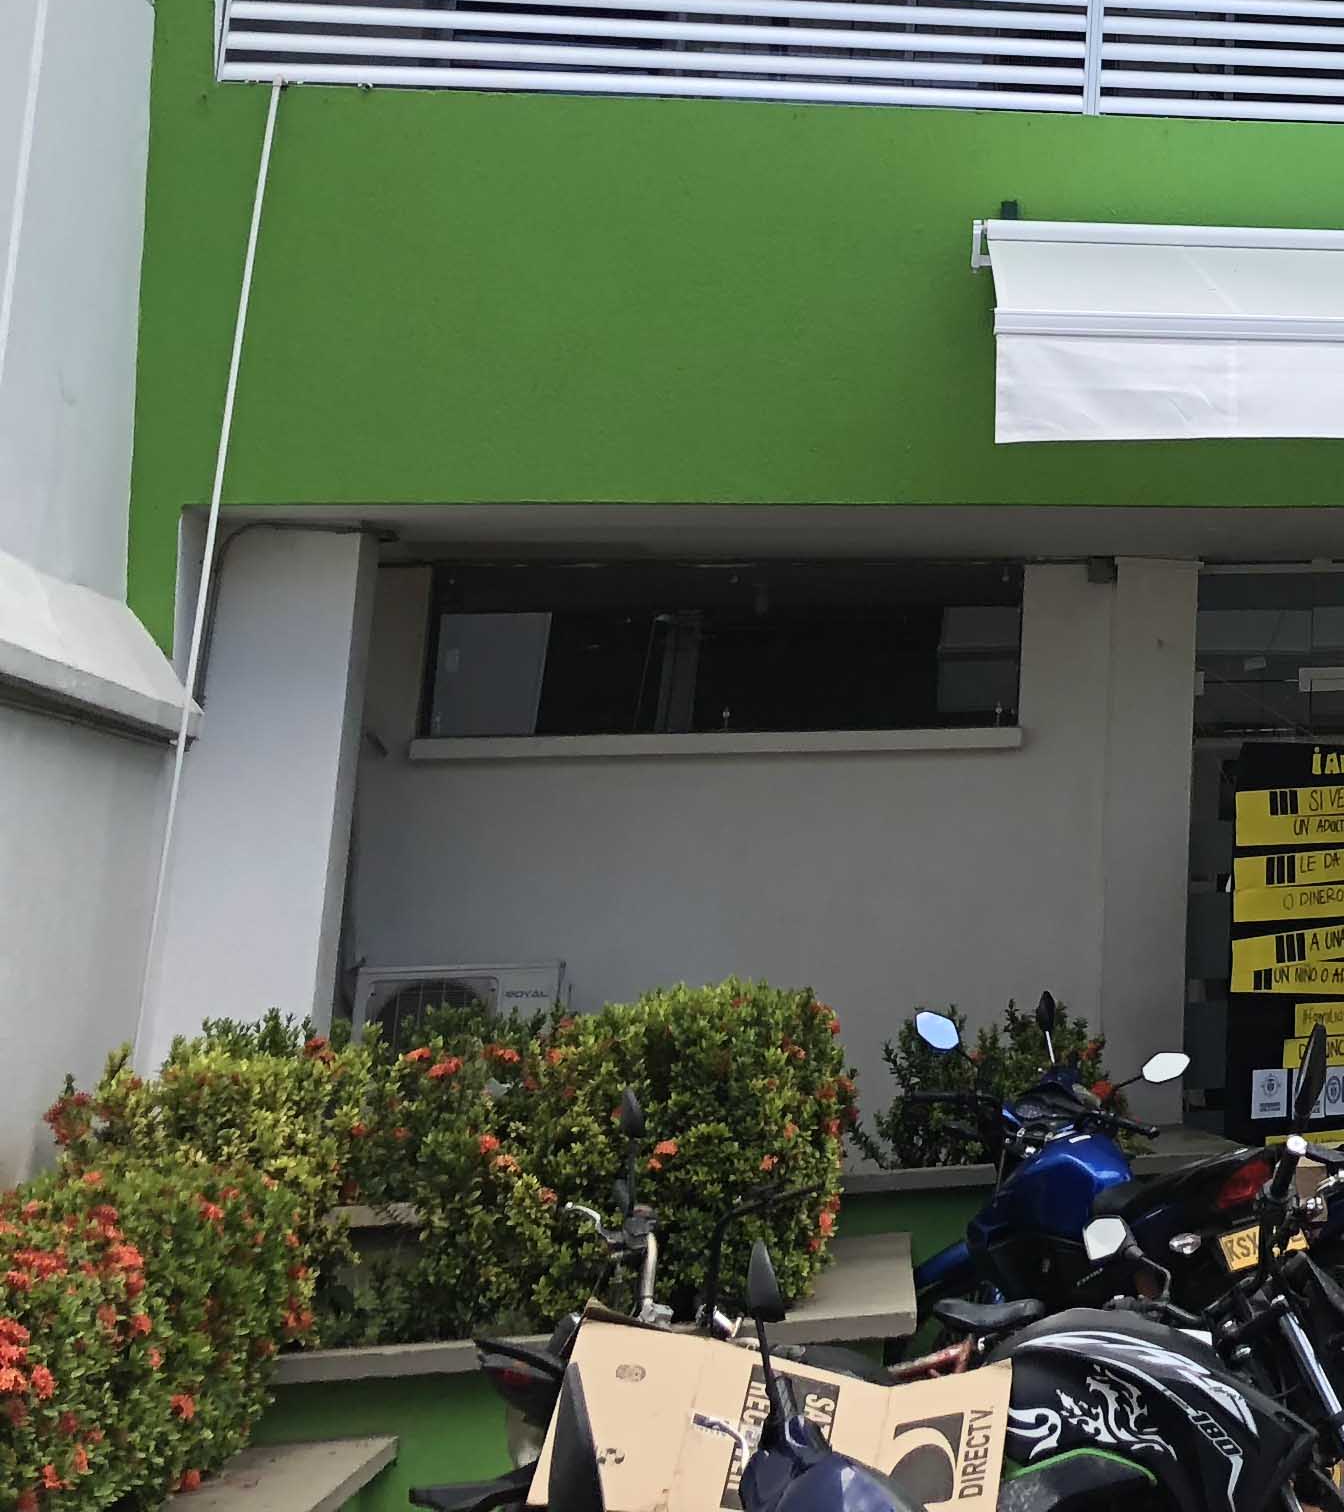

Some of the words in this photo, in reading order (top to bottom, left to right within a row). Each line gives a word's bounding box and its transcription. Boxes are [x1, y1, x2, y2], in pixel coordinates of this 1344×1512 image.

[1309, 790, 1324, 811] SI
[1293, 819, 1310, 835] UN
[1300, 856, 1316, 874] LE
[1324, 852, 1341, 868] DA
[1300, 888, 1344, 906] DINERO
[1310, 935, 1320, 952] A
[1274, 967, 1290, 983] UN
[959, 1408, 994, 1499] DIRECTV
